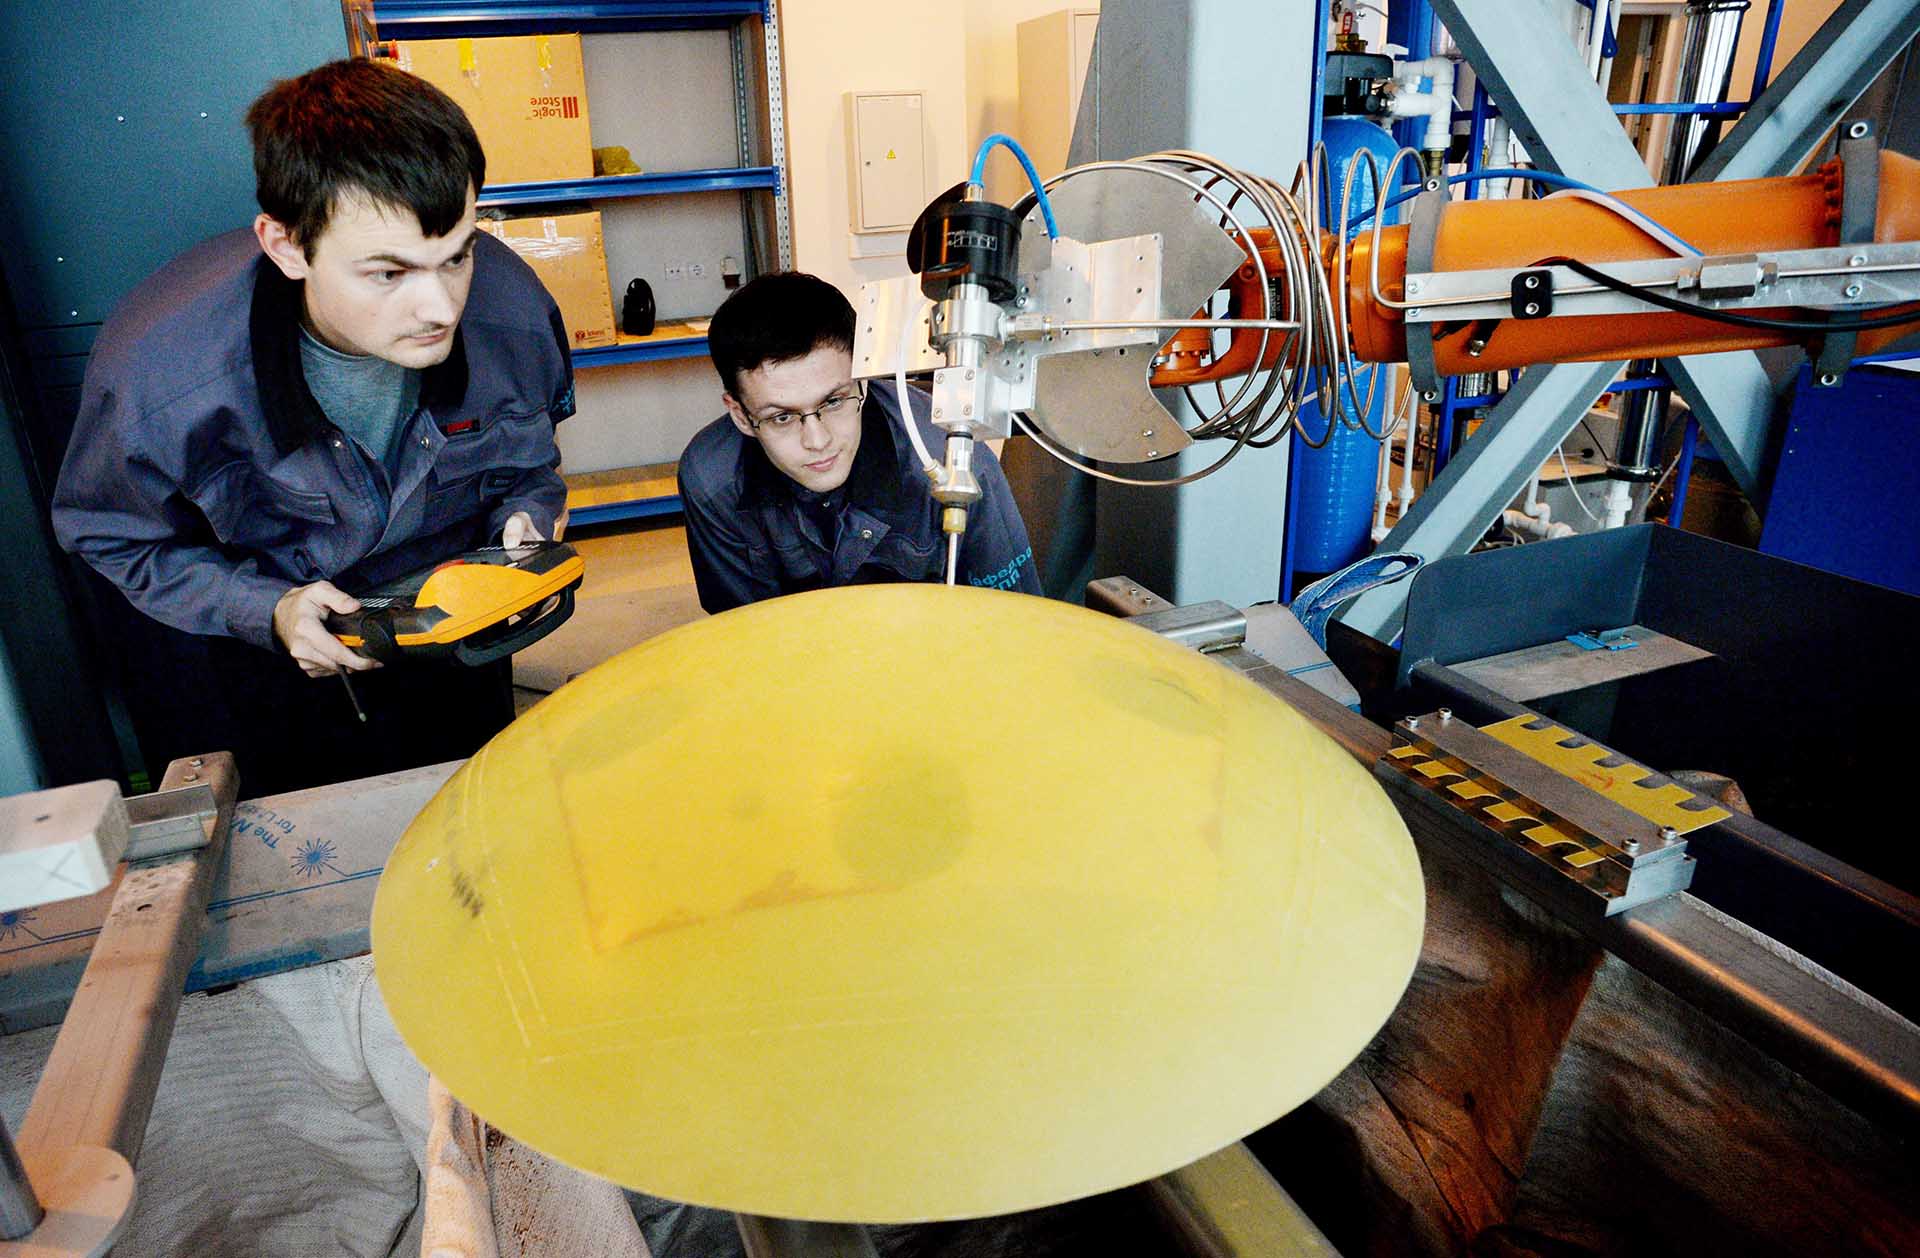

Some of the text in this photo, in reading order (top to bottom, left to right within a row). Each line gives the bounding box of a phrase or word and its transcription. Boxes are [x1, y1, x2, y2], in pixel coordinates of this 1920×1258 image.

[530, 97, 560, 107] Store
[533, 106, 562, 119] Logic
[276, 818, 297, 834] for
[254, 827, 281, 849] The
